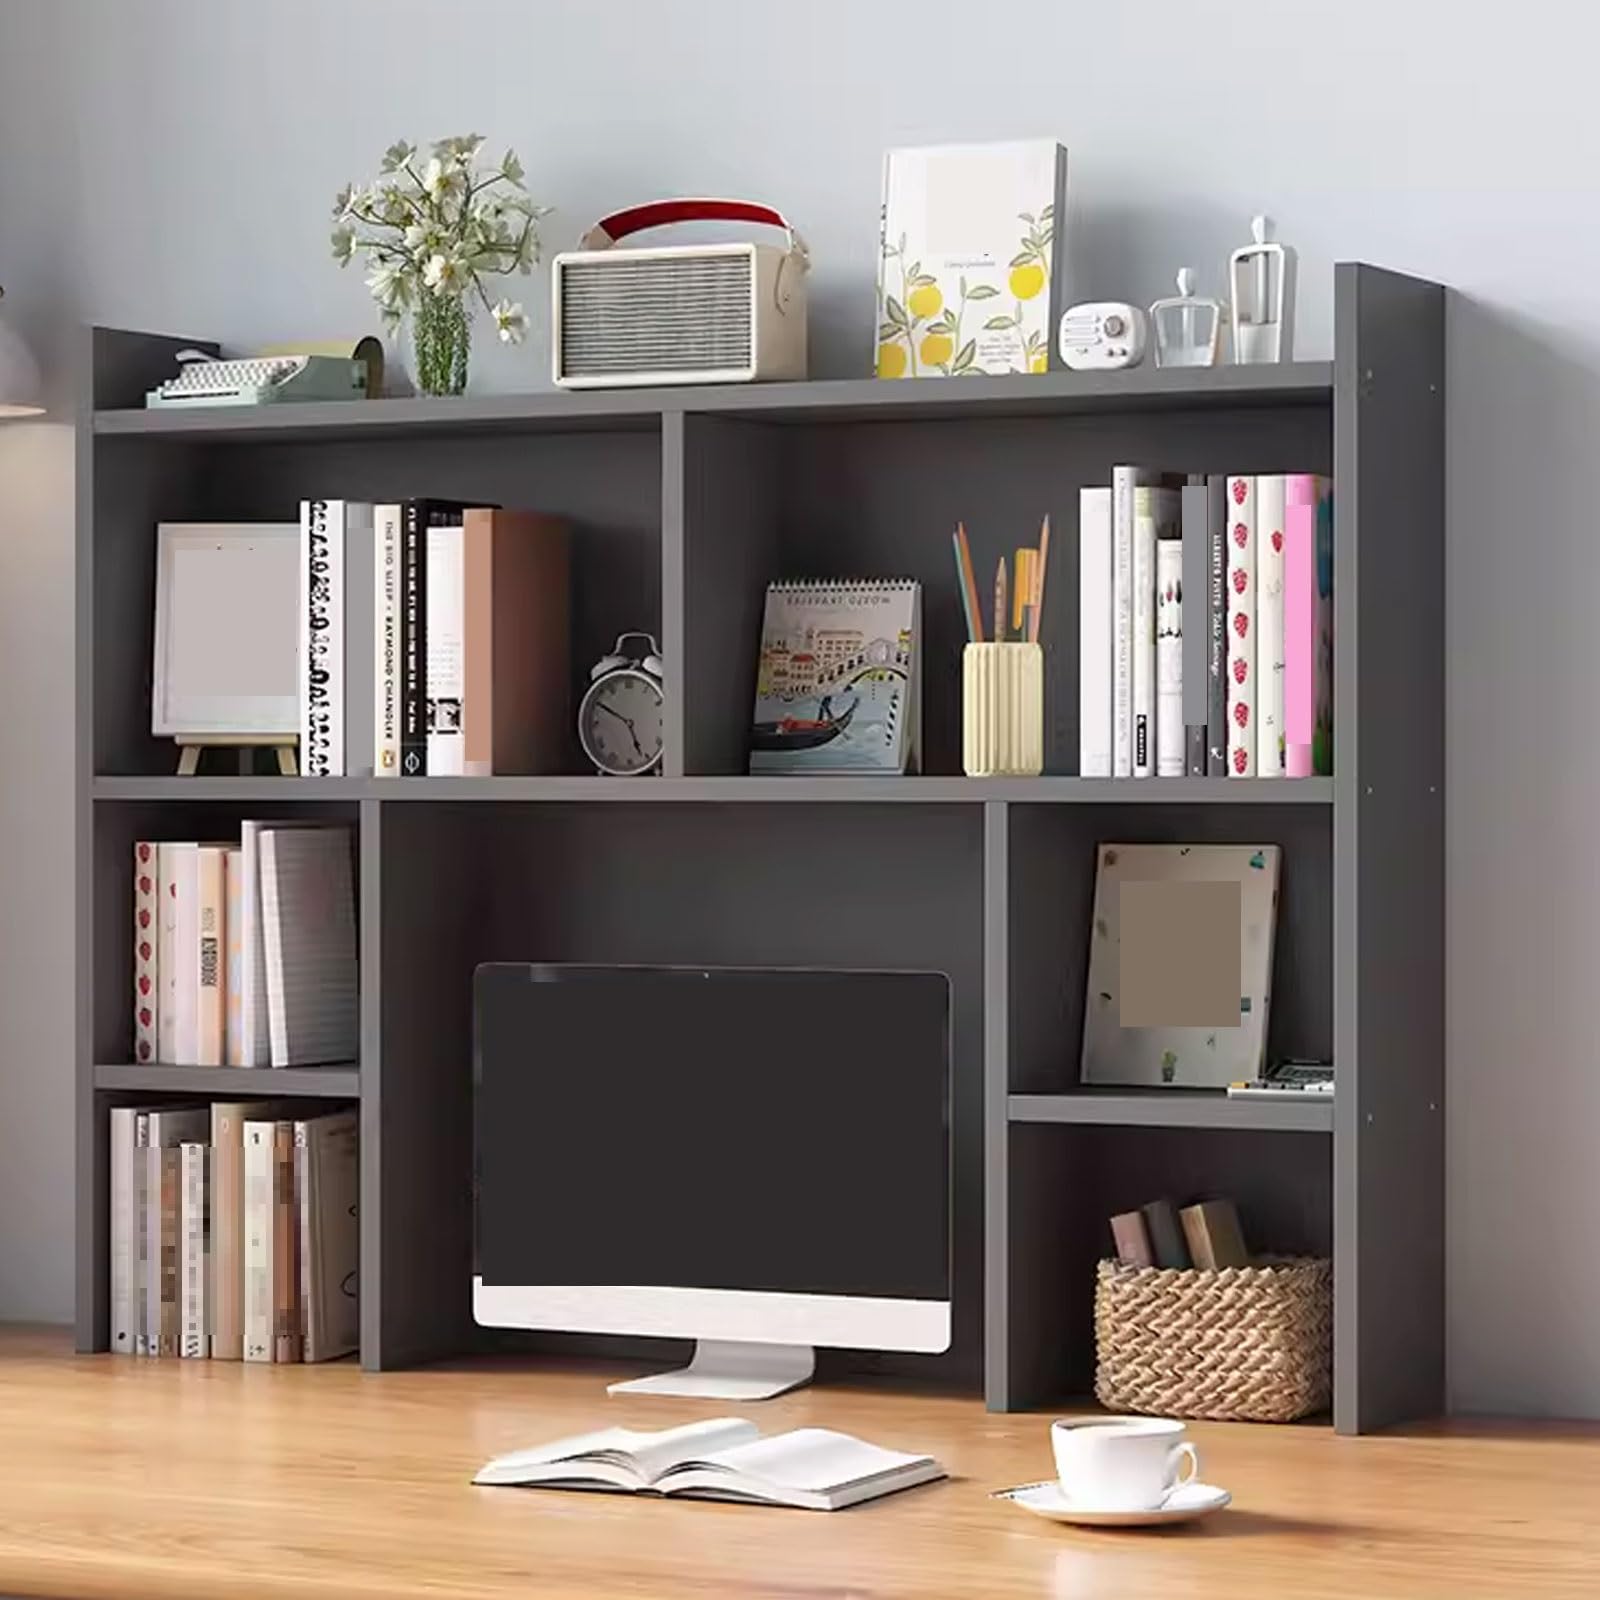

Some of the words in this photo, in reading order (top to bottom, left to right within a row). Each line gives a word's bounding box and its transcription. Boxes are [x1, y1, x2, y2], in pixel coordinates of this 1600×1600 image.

[386, 545, 394, 565] BIG
[386, 570, 394, 601] SLEEP
[385, 616, 393, 676] RAYMOND
[385, 679, 393, 740] CHANDLER
